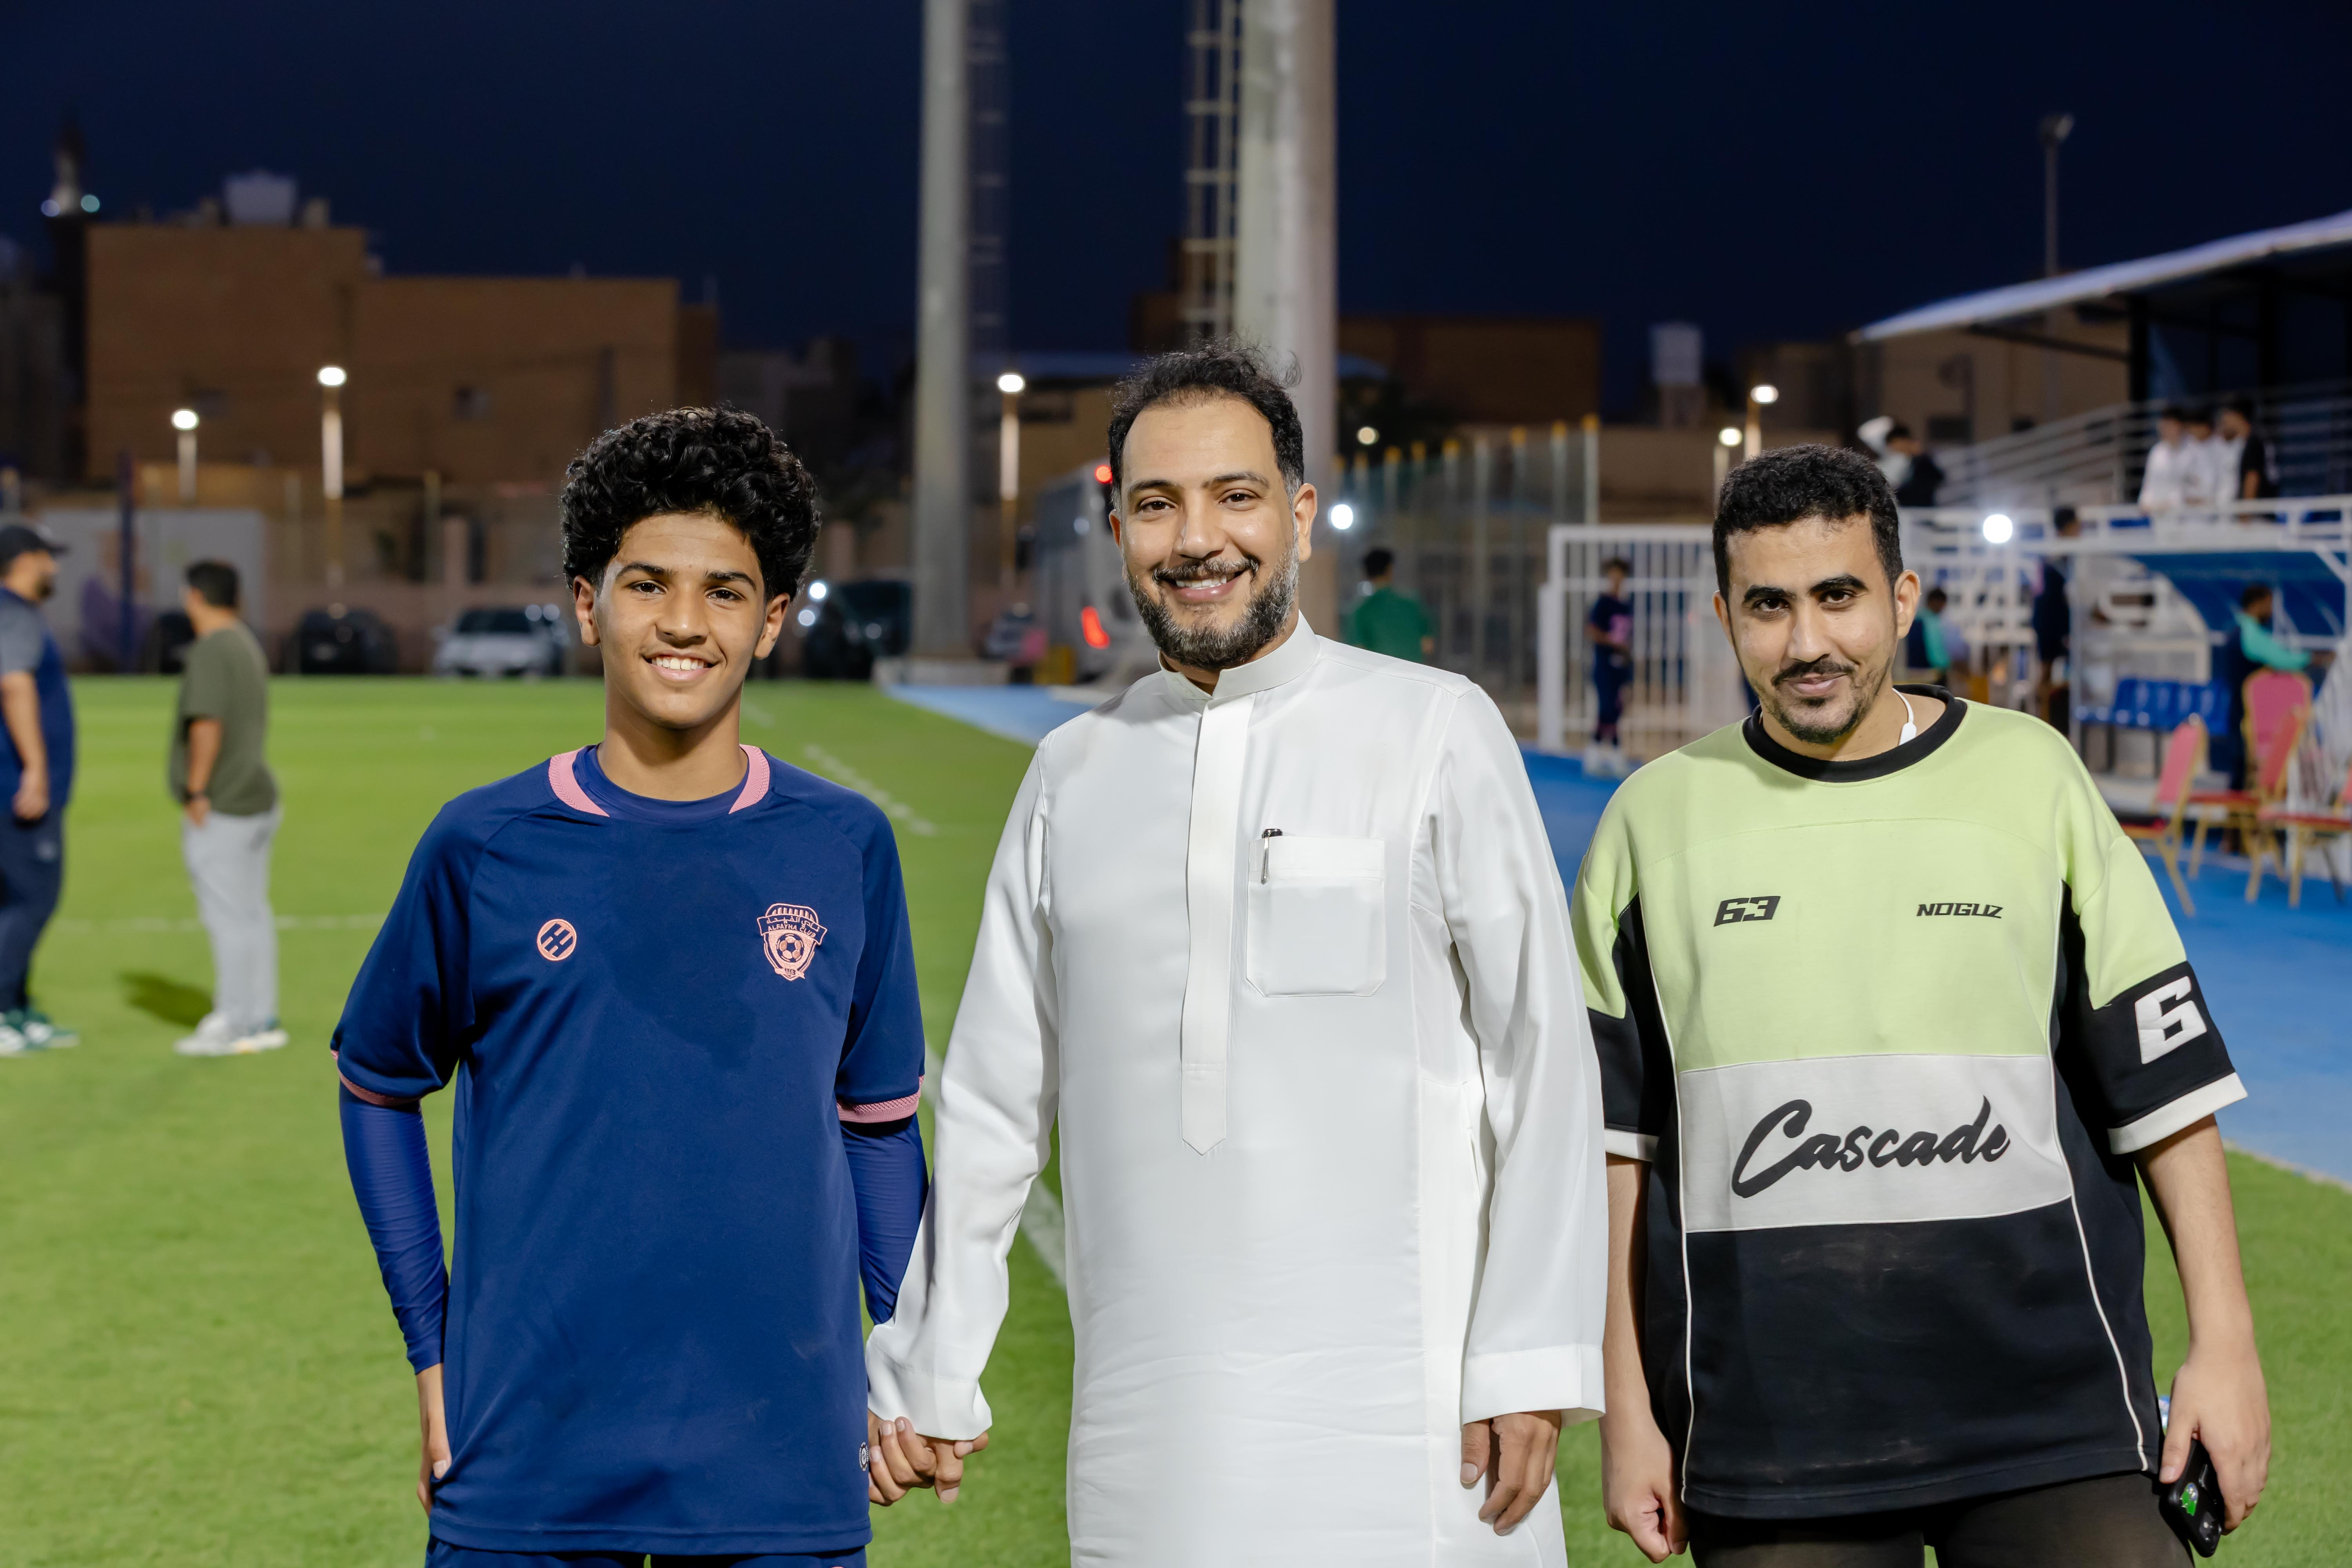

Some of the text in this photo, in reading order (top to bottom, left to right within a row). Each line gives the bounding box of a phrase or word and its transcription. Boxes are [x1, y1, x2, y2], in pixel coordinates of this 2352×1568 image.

[1713, 896, 1781, 927] 63
[1916, 903, 2003, 919] NOGUZ
[800, 927, 816, 938] CLUB
[2135, 976, 2207, 1064] 6
[1731, 1095, 2011, 1199] Cascade
